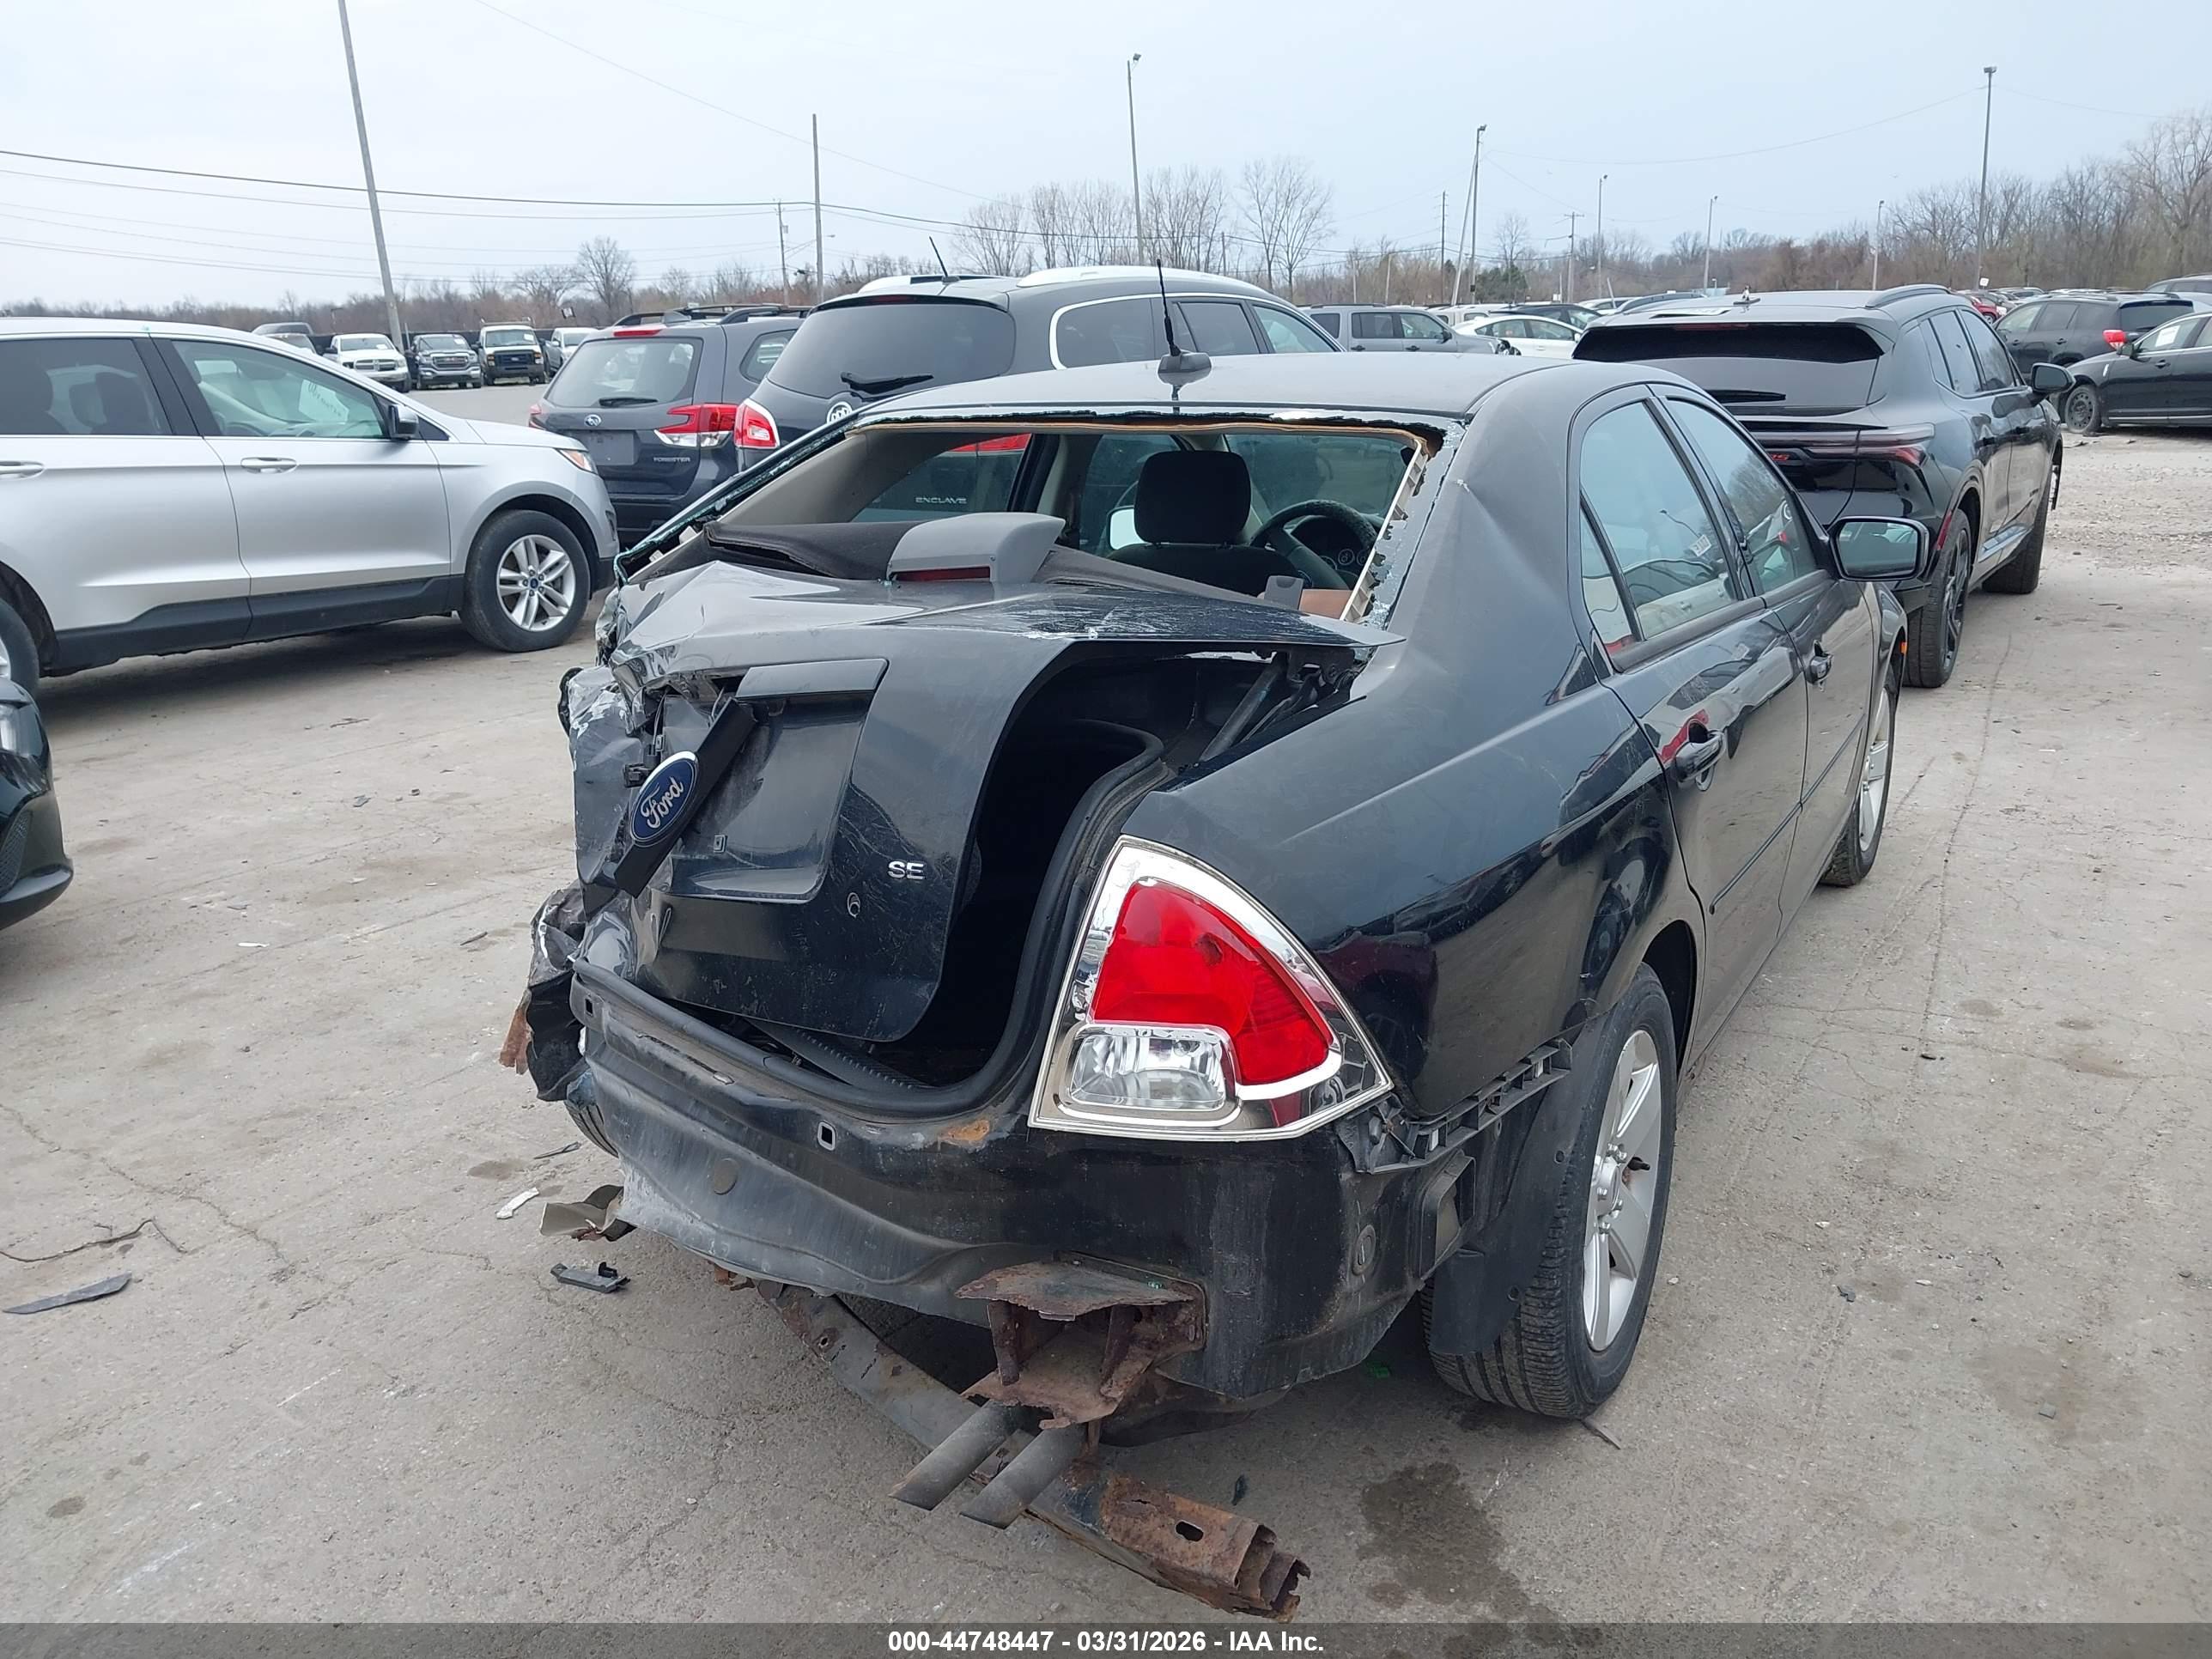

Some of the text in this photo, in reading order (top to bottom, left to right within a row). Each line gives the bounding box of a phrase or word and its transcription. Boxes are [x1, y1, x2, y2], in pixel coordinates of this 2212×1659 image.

[915, 496, 968, 505] ENCLAVE
[640, 775, 684, 830] Ford
[887, 860, 924, 880] SE
